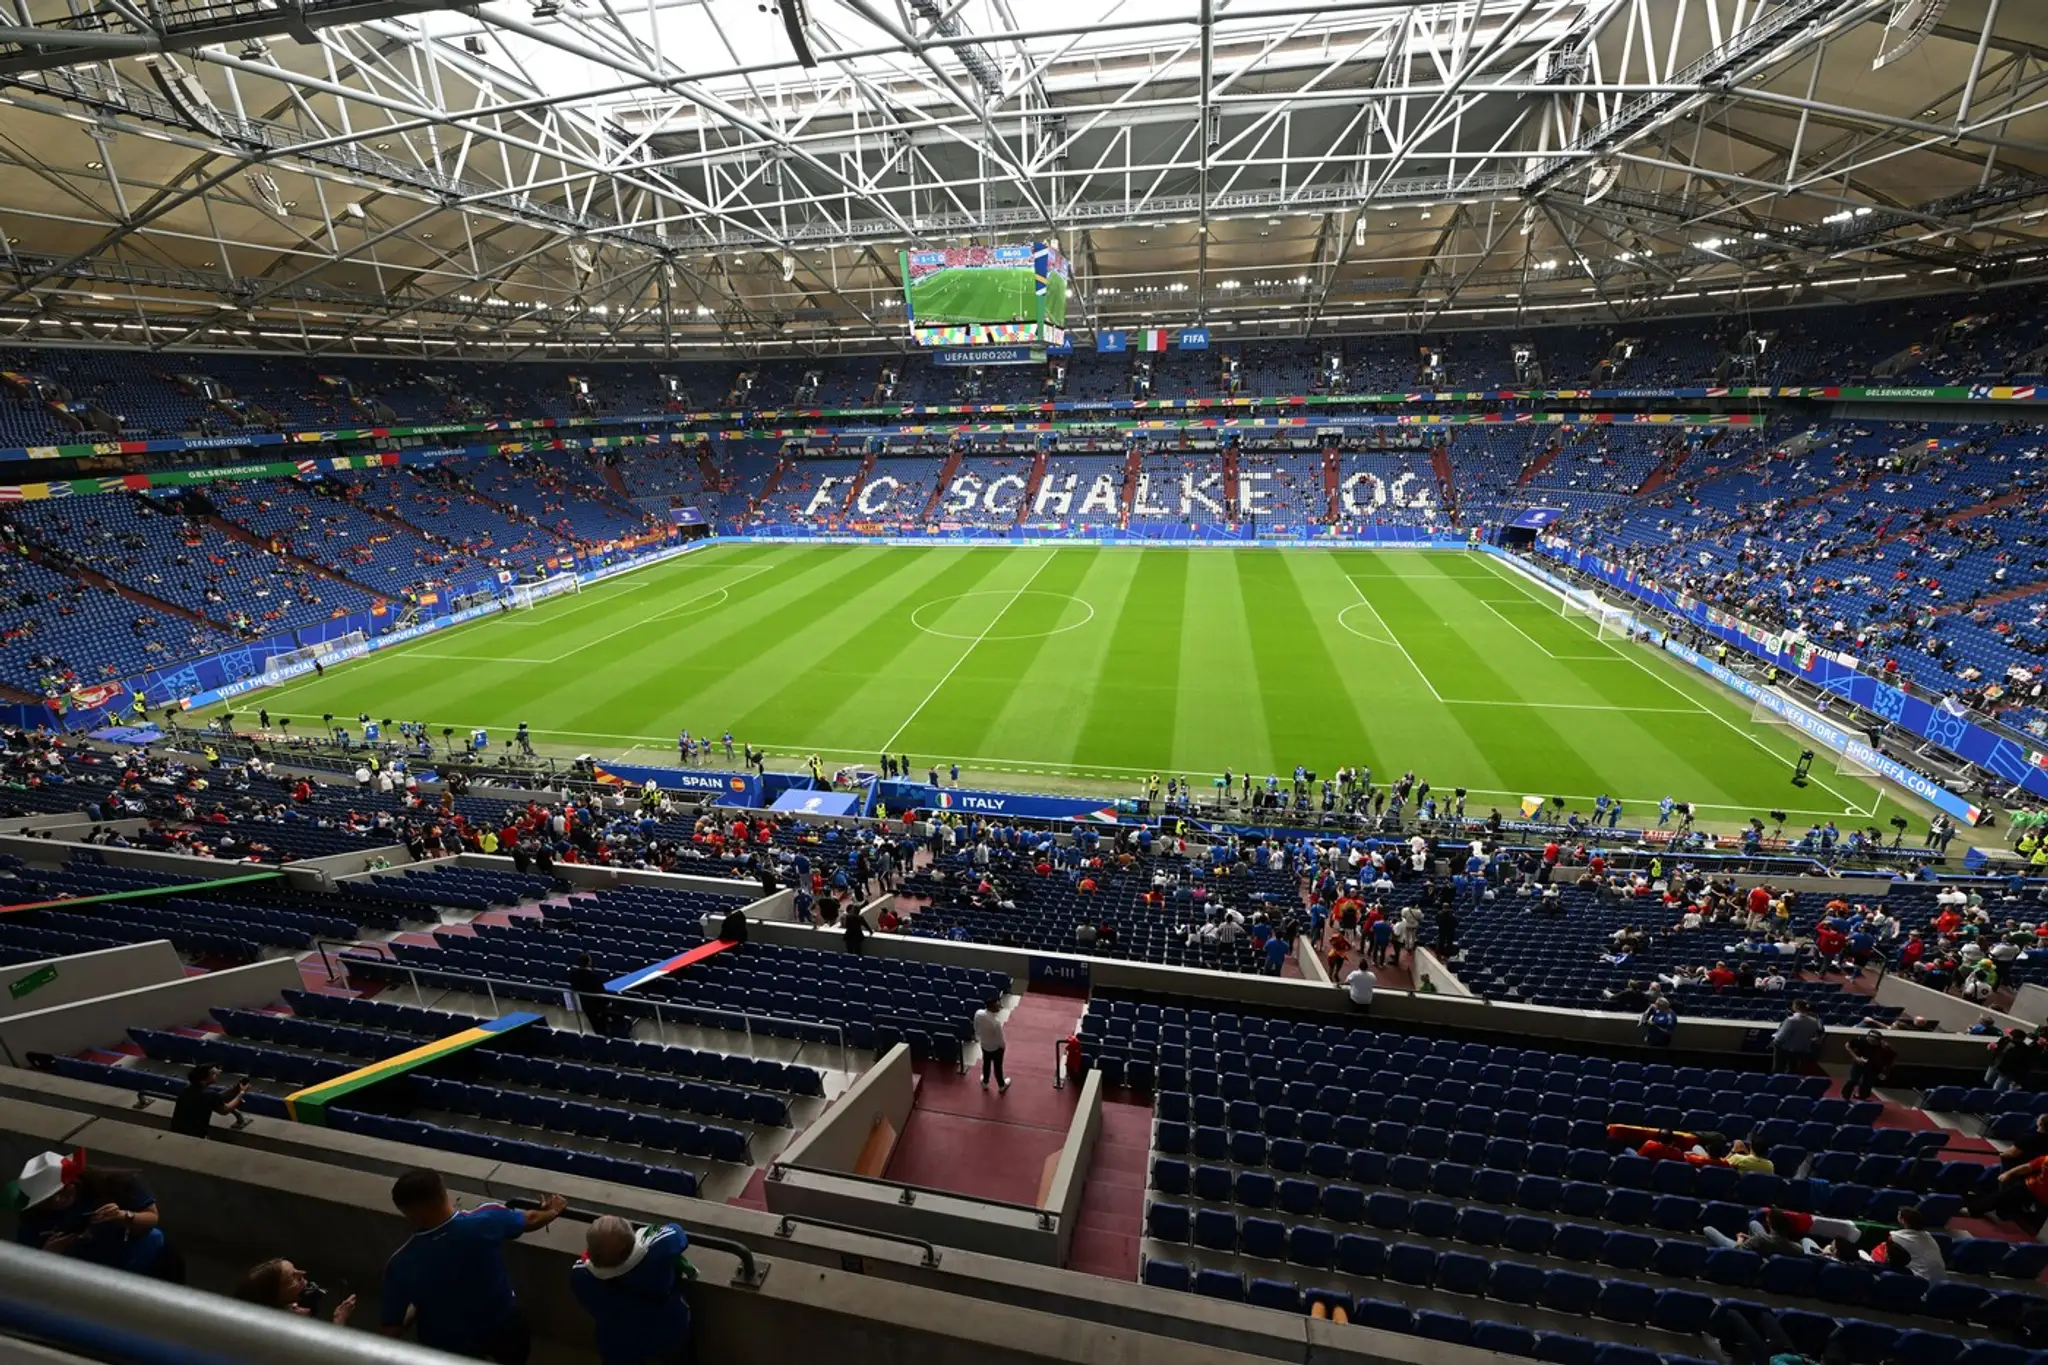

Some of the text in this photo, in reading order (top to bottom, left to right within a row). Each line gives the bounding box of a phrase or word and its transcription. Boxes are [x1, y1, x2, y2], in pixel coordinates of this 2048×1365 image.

[1183, 334, 1205, 344] FIFA
[1327, 395, 1382, 403] GELSENKIRCHEN
[1865, 388, 1935, 397] GELSENKIRCHEN
[188, 465, 268, 478] GELSENKIRCHEN
[805, 475, 899, 516] FC
[944, 472, 1273, 516] SCHALKE
[1276, 540, 1293, 548] VISIT
[1293, 540, 1306, 548] THE
[1307, 540, 1336, 548] OFFICIAL
[1336, 540, 1352, 548] UEFA
[1354, 540, 1375, 548] STORE
[1382, 540, 1433, 548] SHOPUEFA.COM
[216, 682, 246, 698] VISIT
[248, 674, 270, 691] THE
[318, 652, 341, 667] UEFA
[377, 622, 436, 646] SHOPUEFA.COM
[1712, 665, 1730, 682] VISIT
[1730, 676, 1745, 691] THE
[1745, 683, 1781, 709] OFFICIAL
[1781, 700, 1805, 725] UEFA
[1806, 718, 1838, 743] STORE
[1846, 740, 1938, 800] SHOPUEFA.COM
[682, 776, 723, 789] SPAIN
[962, 796, 1006, 809] ITALY
[1044, 965, 1075, 978] A-III
